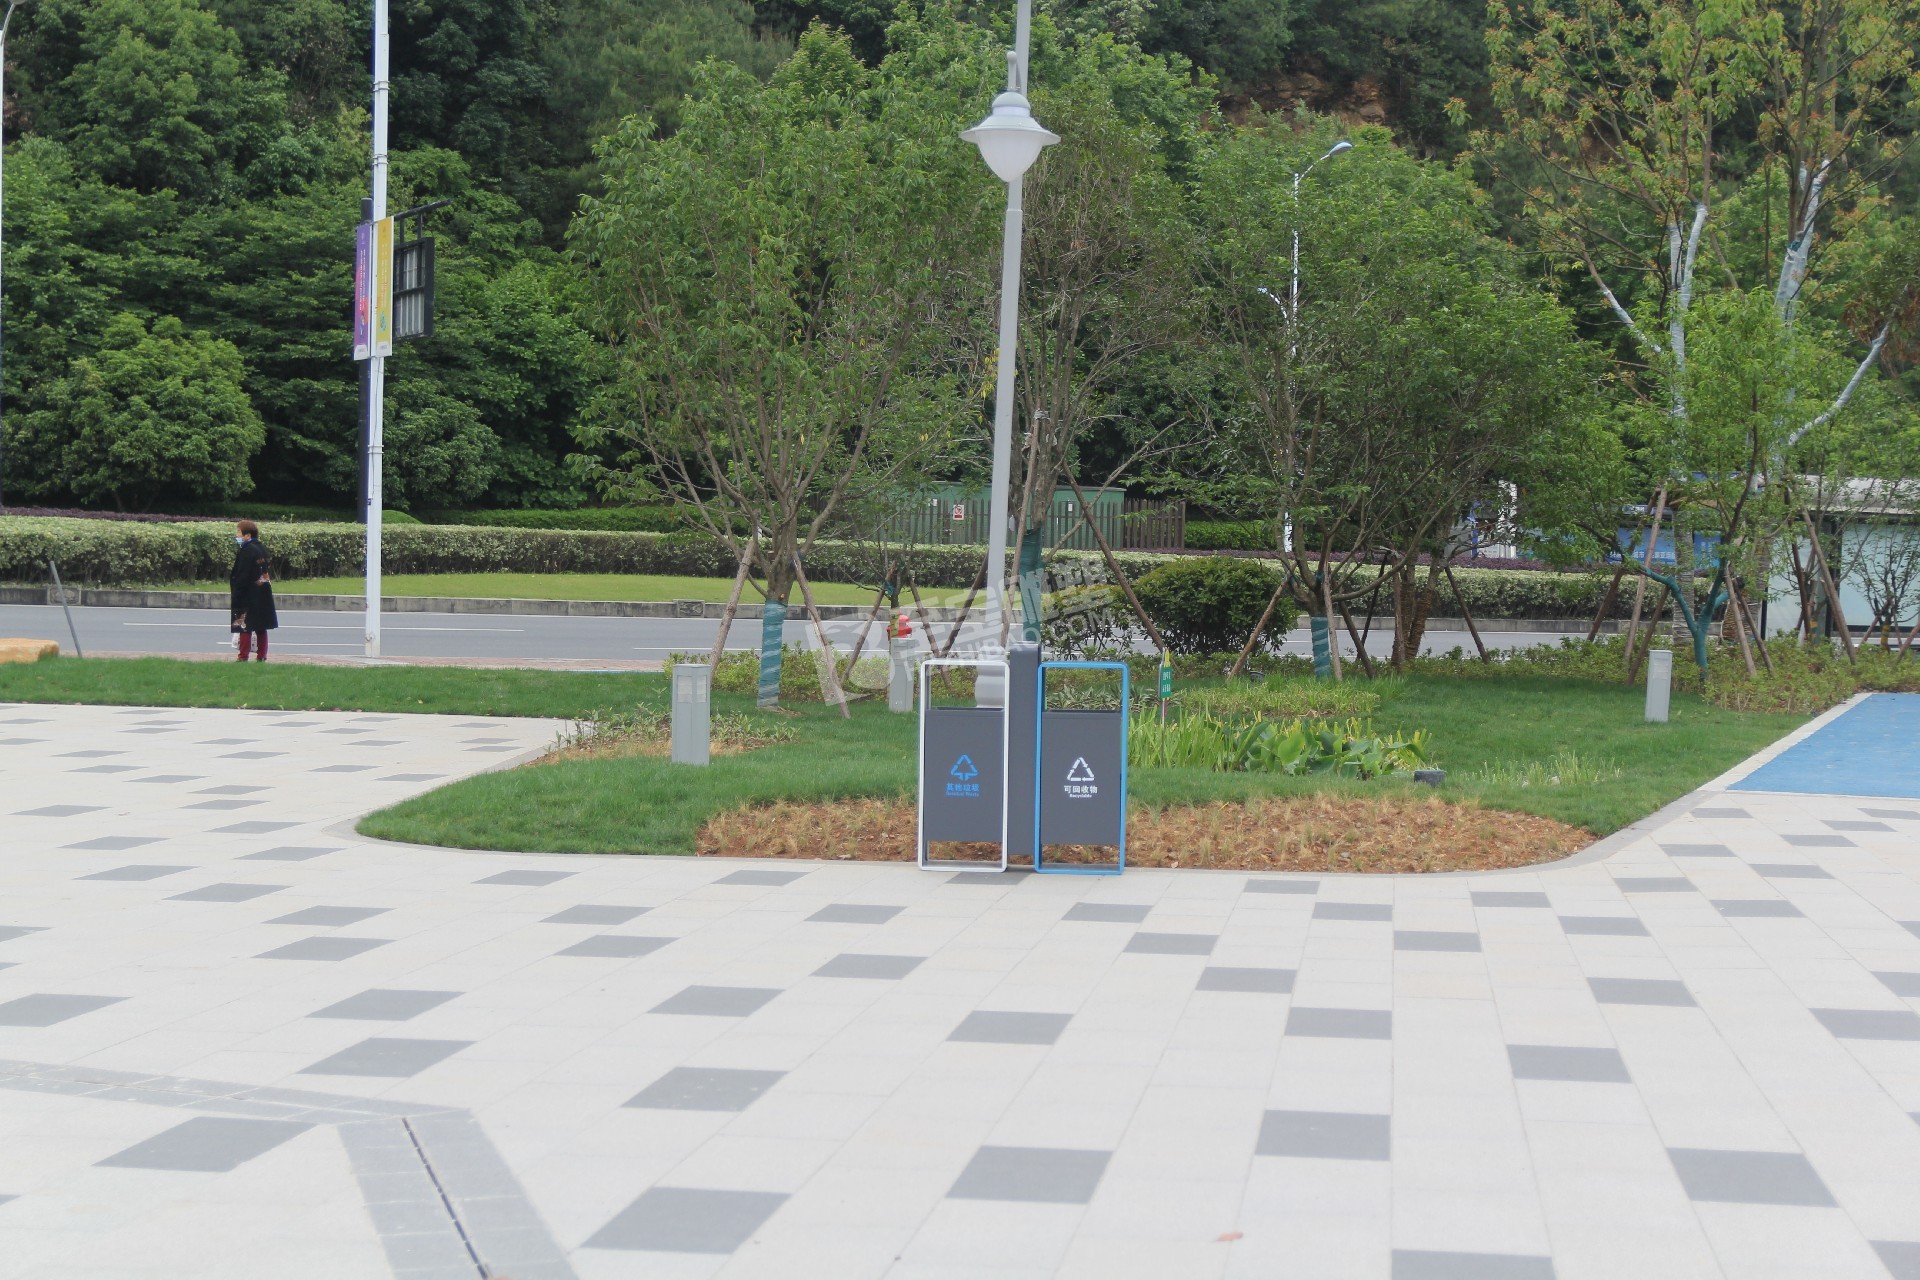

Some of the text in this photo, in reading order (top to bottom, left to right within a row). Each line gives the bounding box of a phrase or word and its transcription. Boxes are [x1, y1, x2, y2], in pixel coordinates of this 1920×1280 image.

[946, 782, 979, 791] 其他垃圾
[1063, 785, 1098, 794] 可回收物
